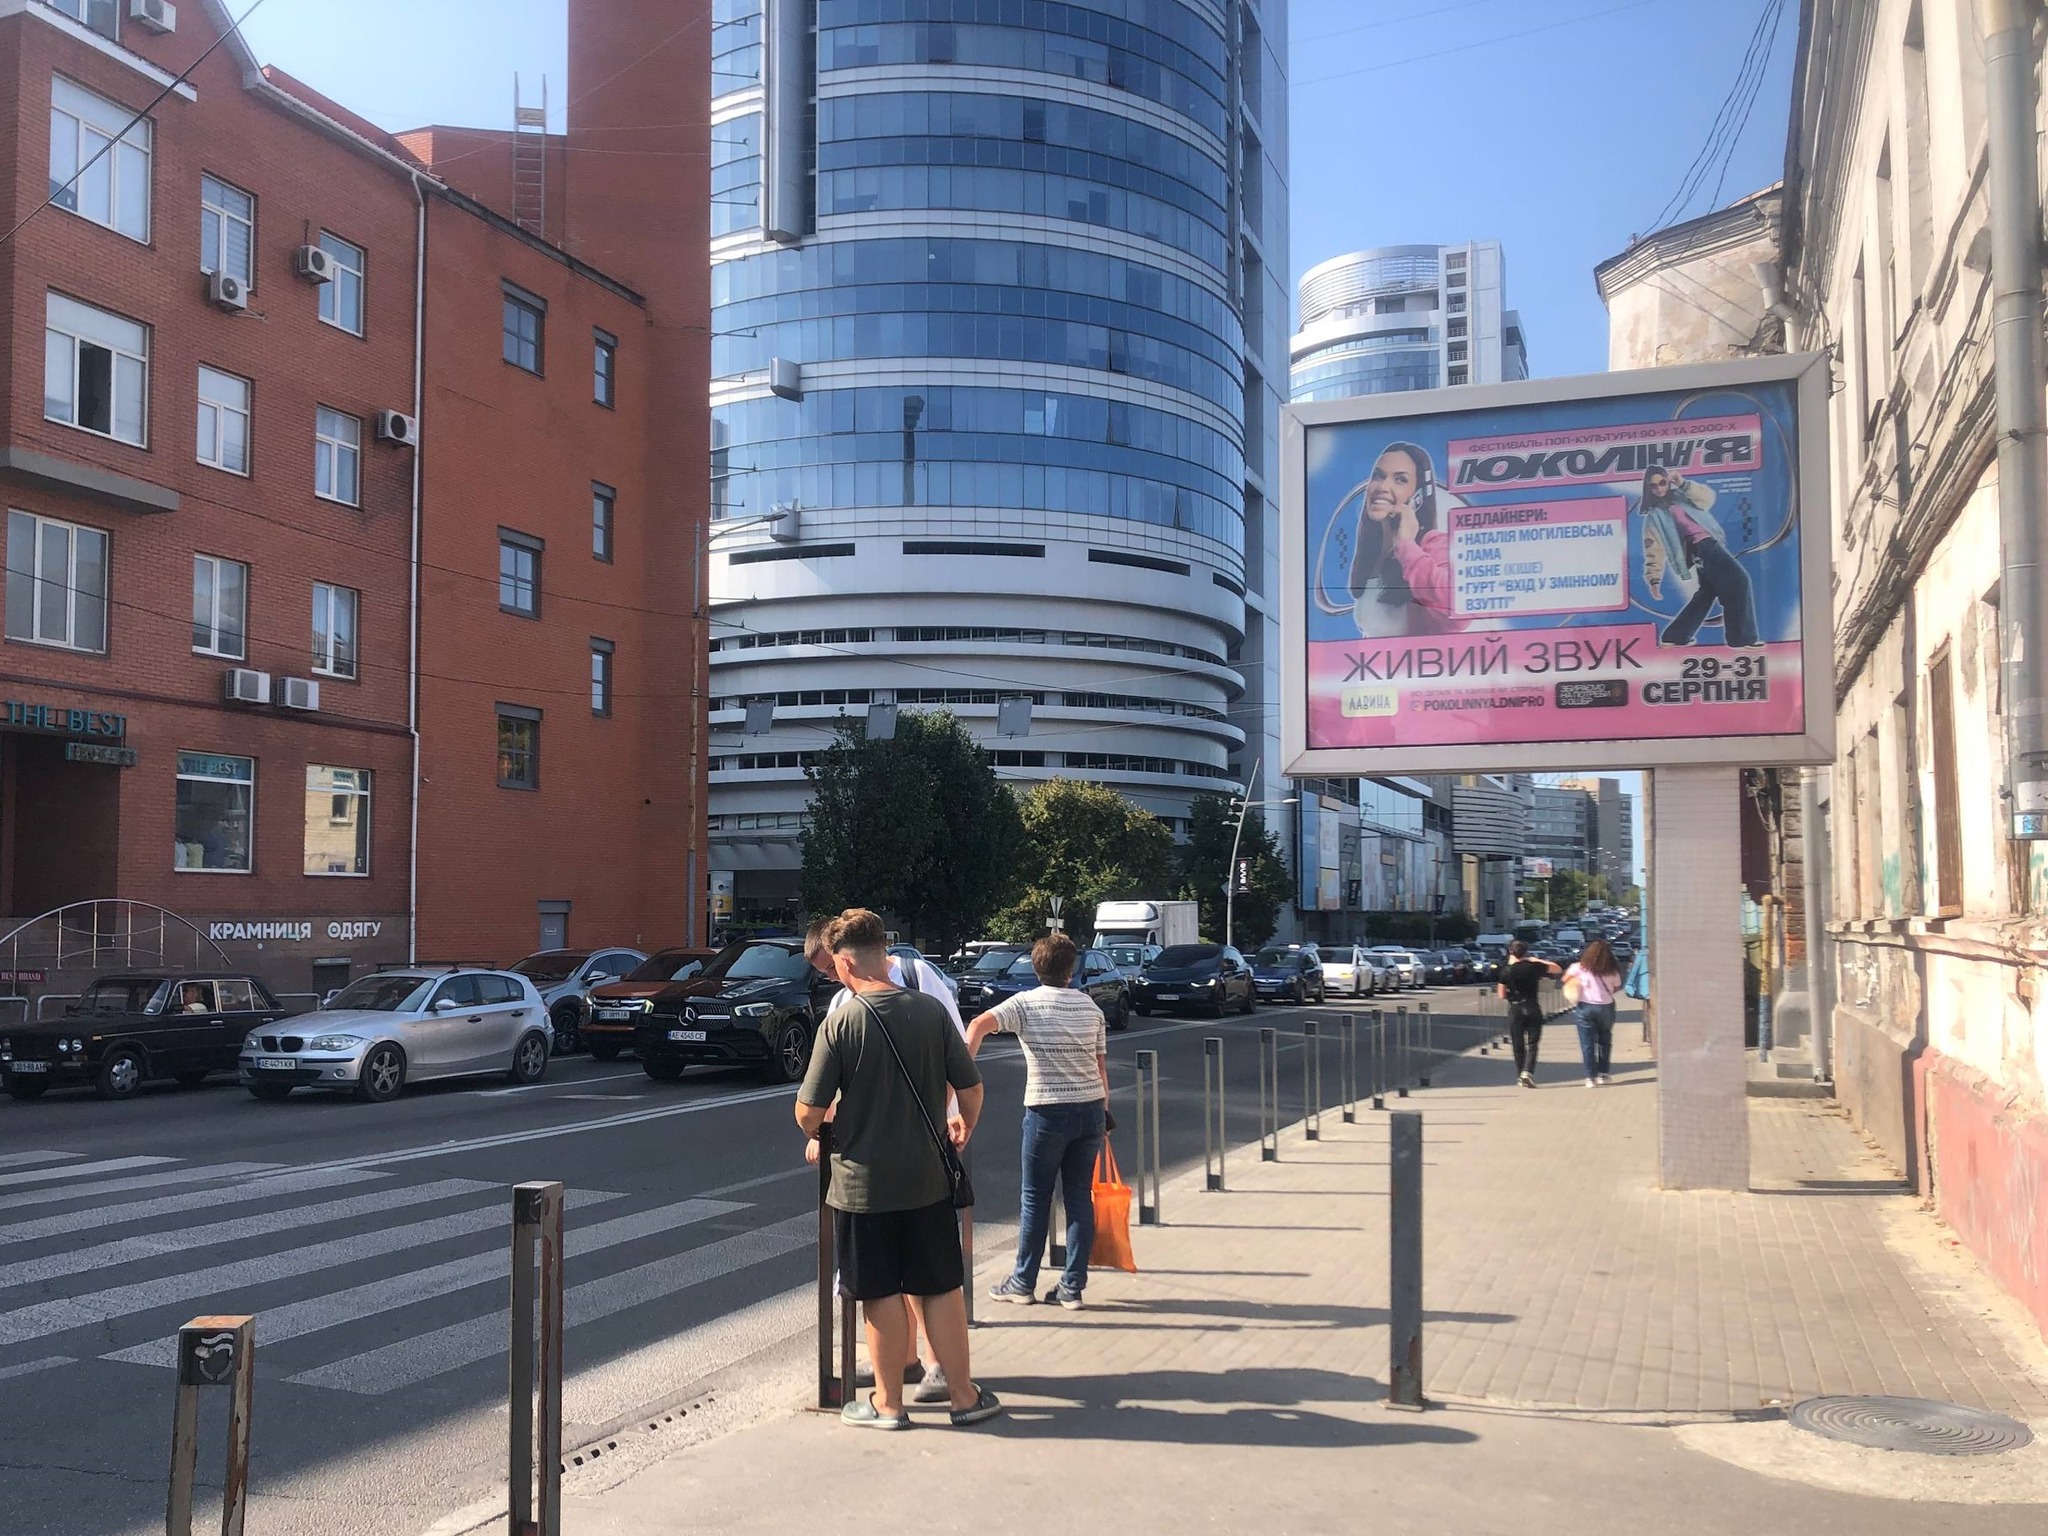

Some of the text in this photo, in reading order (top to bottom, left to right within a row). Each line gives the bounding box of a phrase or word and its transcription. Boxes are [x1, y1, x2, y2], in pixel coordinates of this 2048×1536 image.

[1469, 440, 1543, 452] ФЕСТИВАЛЬ
[1545, 430, 1637, 446] ПОП-КУЛЬТУРИ
[1673, 426, 1687, 436] ТА
[1456, 507, 1548, 528] ХЕДЛАЙНЕРИ:
[1465, 523, 1614, 546] НАТАЛІЯ МОГИЛЕВСЬКА
[1465, 547, 1501, 561] ЛАМА
[1465, 564, 1501, 578] KISHE
[1465, 580, 1496, 594] ГУРТ
[1538, 577, 1547, 590] У
[1550, 573, 1619, 590] ЗМІННОМУ
[1342, 636, 1644, 682] ЖИВИЙ ЗВУК
[1682, 655, 1767, 679] 29-31
[1642, 678, 1768, 704] СЕРПНЯ
[1348, 694, 1391, 711] ЛАВИНА
[6, 699, 127, 737] THE BEST
[210, 921, 382, 941] КРАМНИЦЯ ОДЯГУ
[671, 1031, 679, 1039] AE
